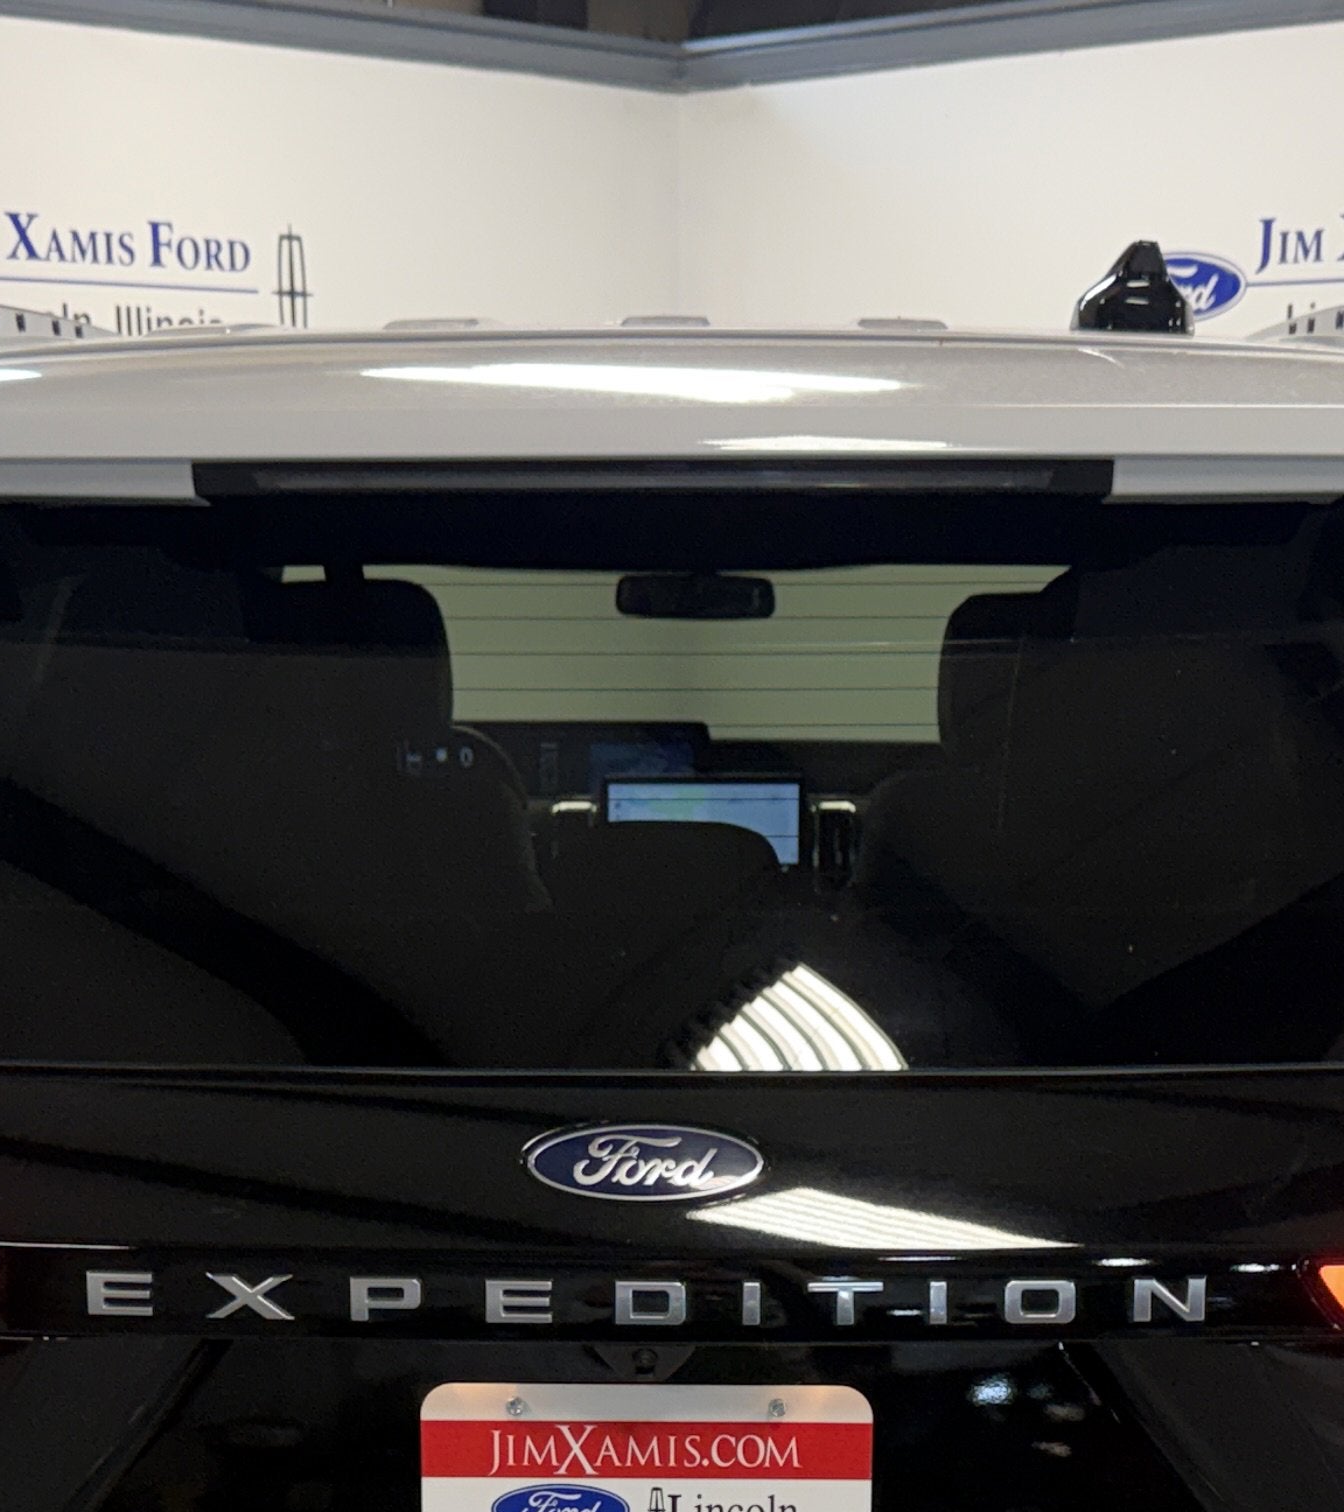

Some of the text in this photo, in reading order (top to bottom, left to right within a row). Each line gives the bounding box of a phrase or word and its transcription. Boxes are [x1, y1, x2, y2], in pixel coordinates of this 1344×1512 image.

[5, 212, 135, 267] XAMIS
[147, 220, 251, 273] FORD
[1256, 216, 1323, 274] JIM
[573, 1134, 718, 1186] Ford
[86, 1270, 1207, 1324] EXPEDITION
[489, 1425, 802, 1475] JIMXAMIS.COM
